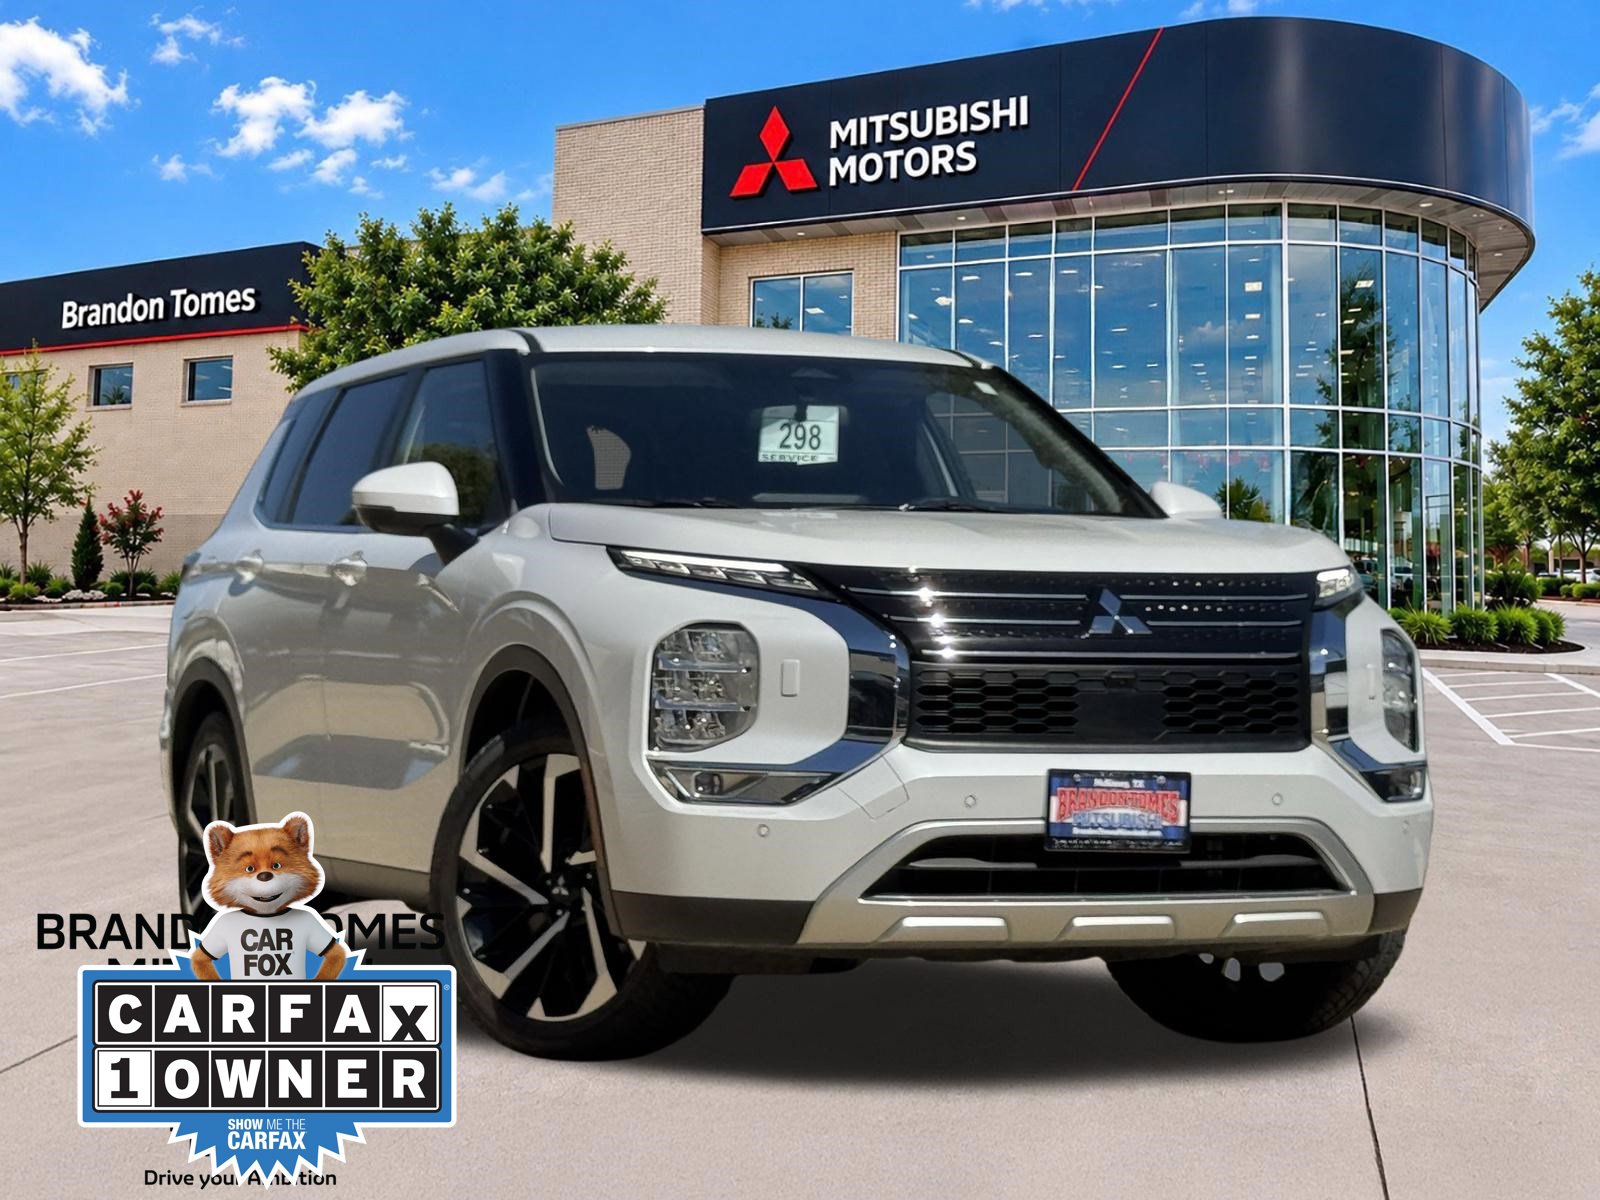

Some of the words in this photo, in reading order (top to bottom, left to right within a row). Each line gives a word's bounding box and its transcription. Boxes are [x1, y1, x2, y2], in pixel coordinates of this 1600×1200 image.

[830, 95, 1028, 149] MITSUBISHI
[829, 141, 977, 186] MOTORS
[61, 293, 164, 329] Brandon
[170, 288, 256, 318] Tomes
[779, 422, 821, 450] 298
